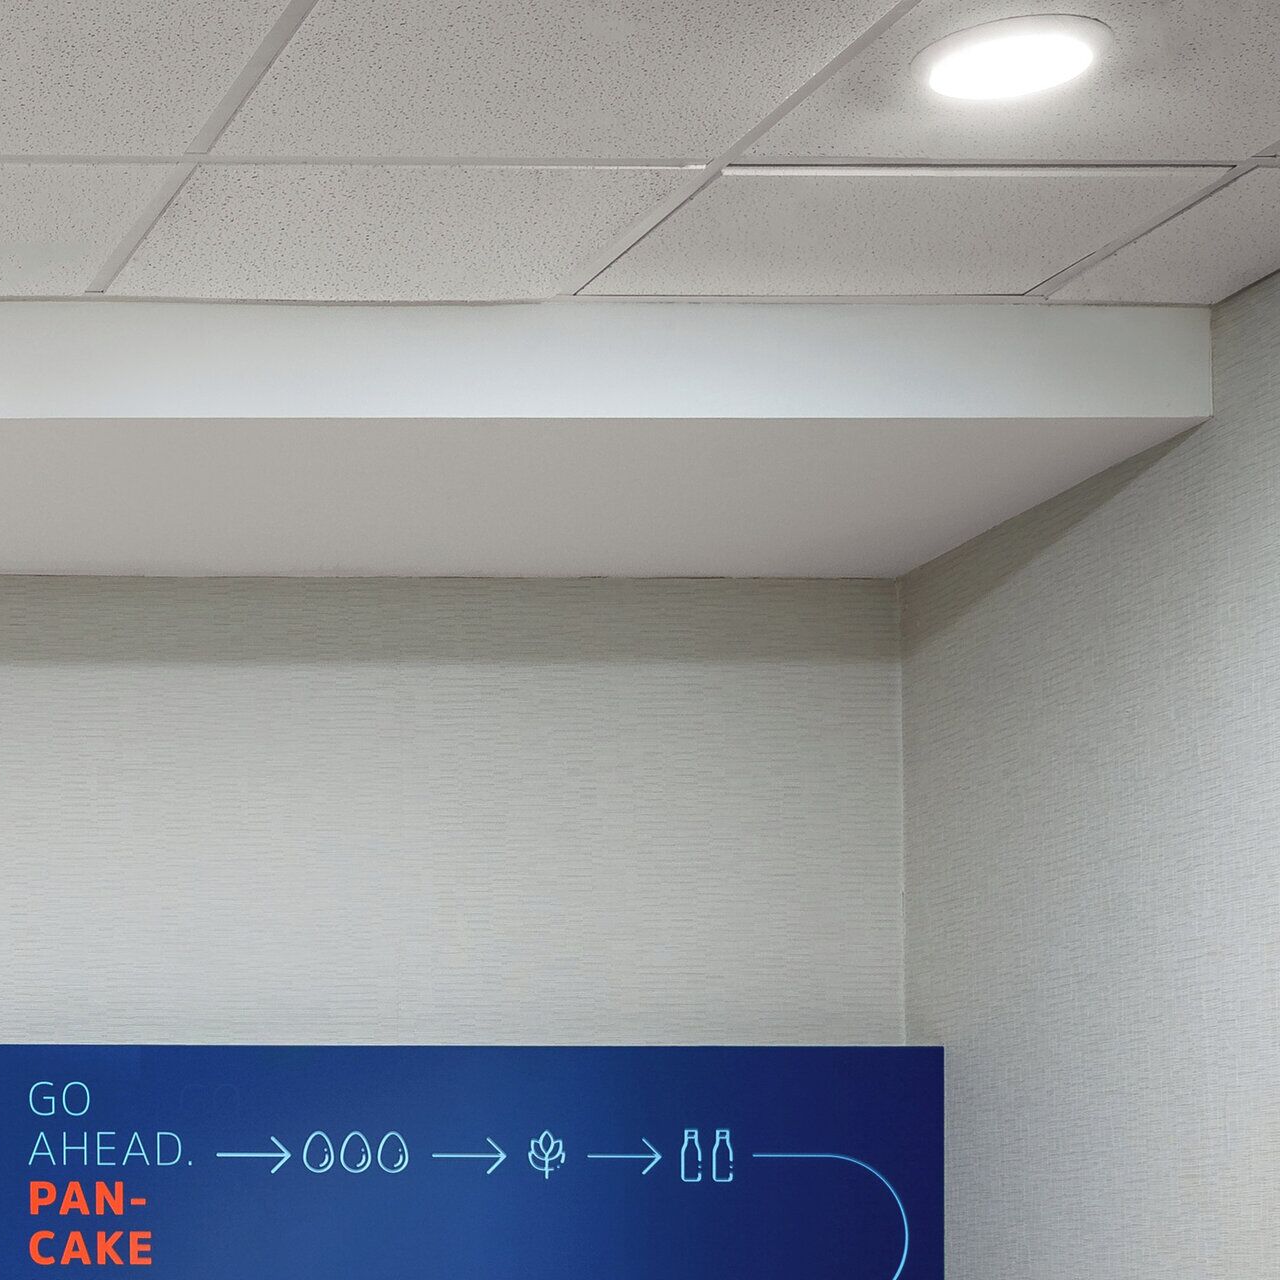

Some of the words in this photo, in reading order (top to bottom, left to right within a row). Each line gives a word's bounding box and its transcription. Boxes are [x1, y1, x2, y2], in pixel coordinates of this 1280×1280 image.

[28, 1081, 91, 1116] GO
[28, 1131, 193, 1166] AHEAD.
[28, 1181, 147, 1216] PAN-
[28, 1230, 153, 1266] CAKE
